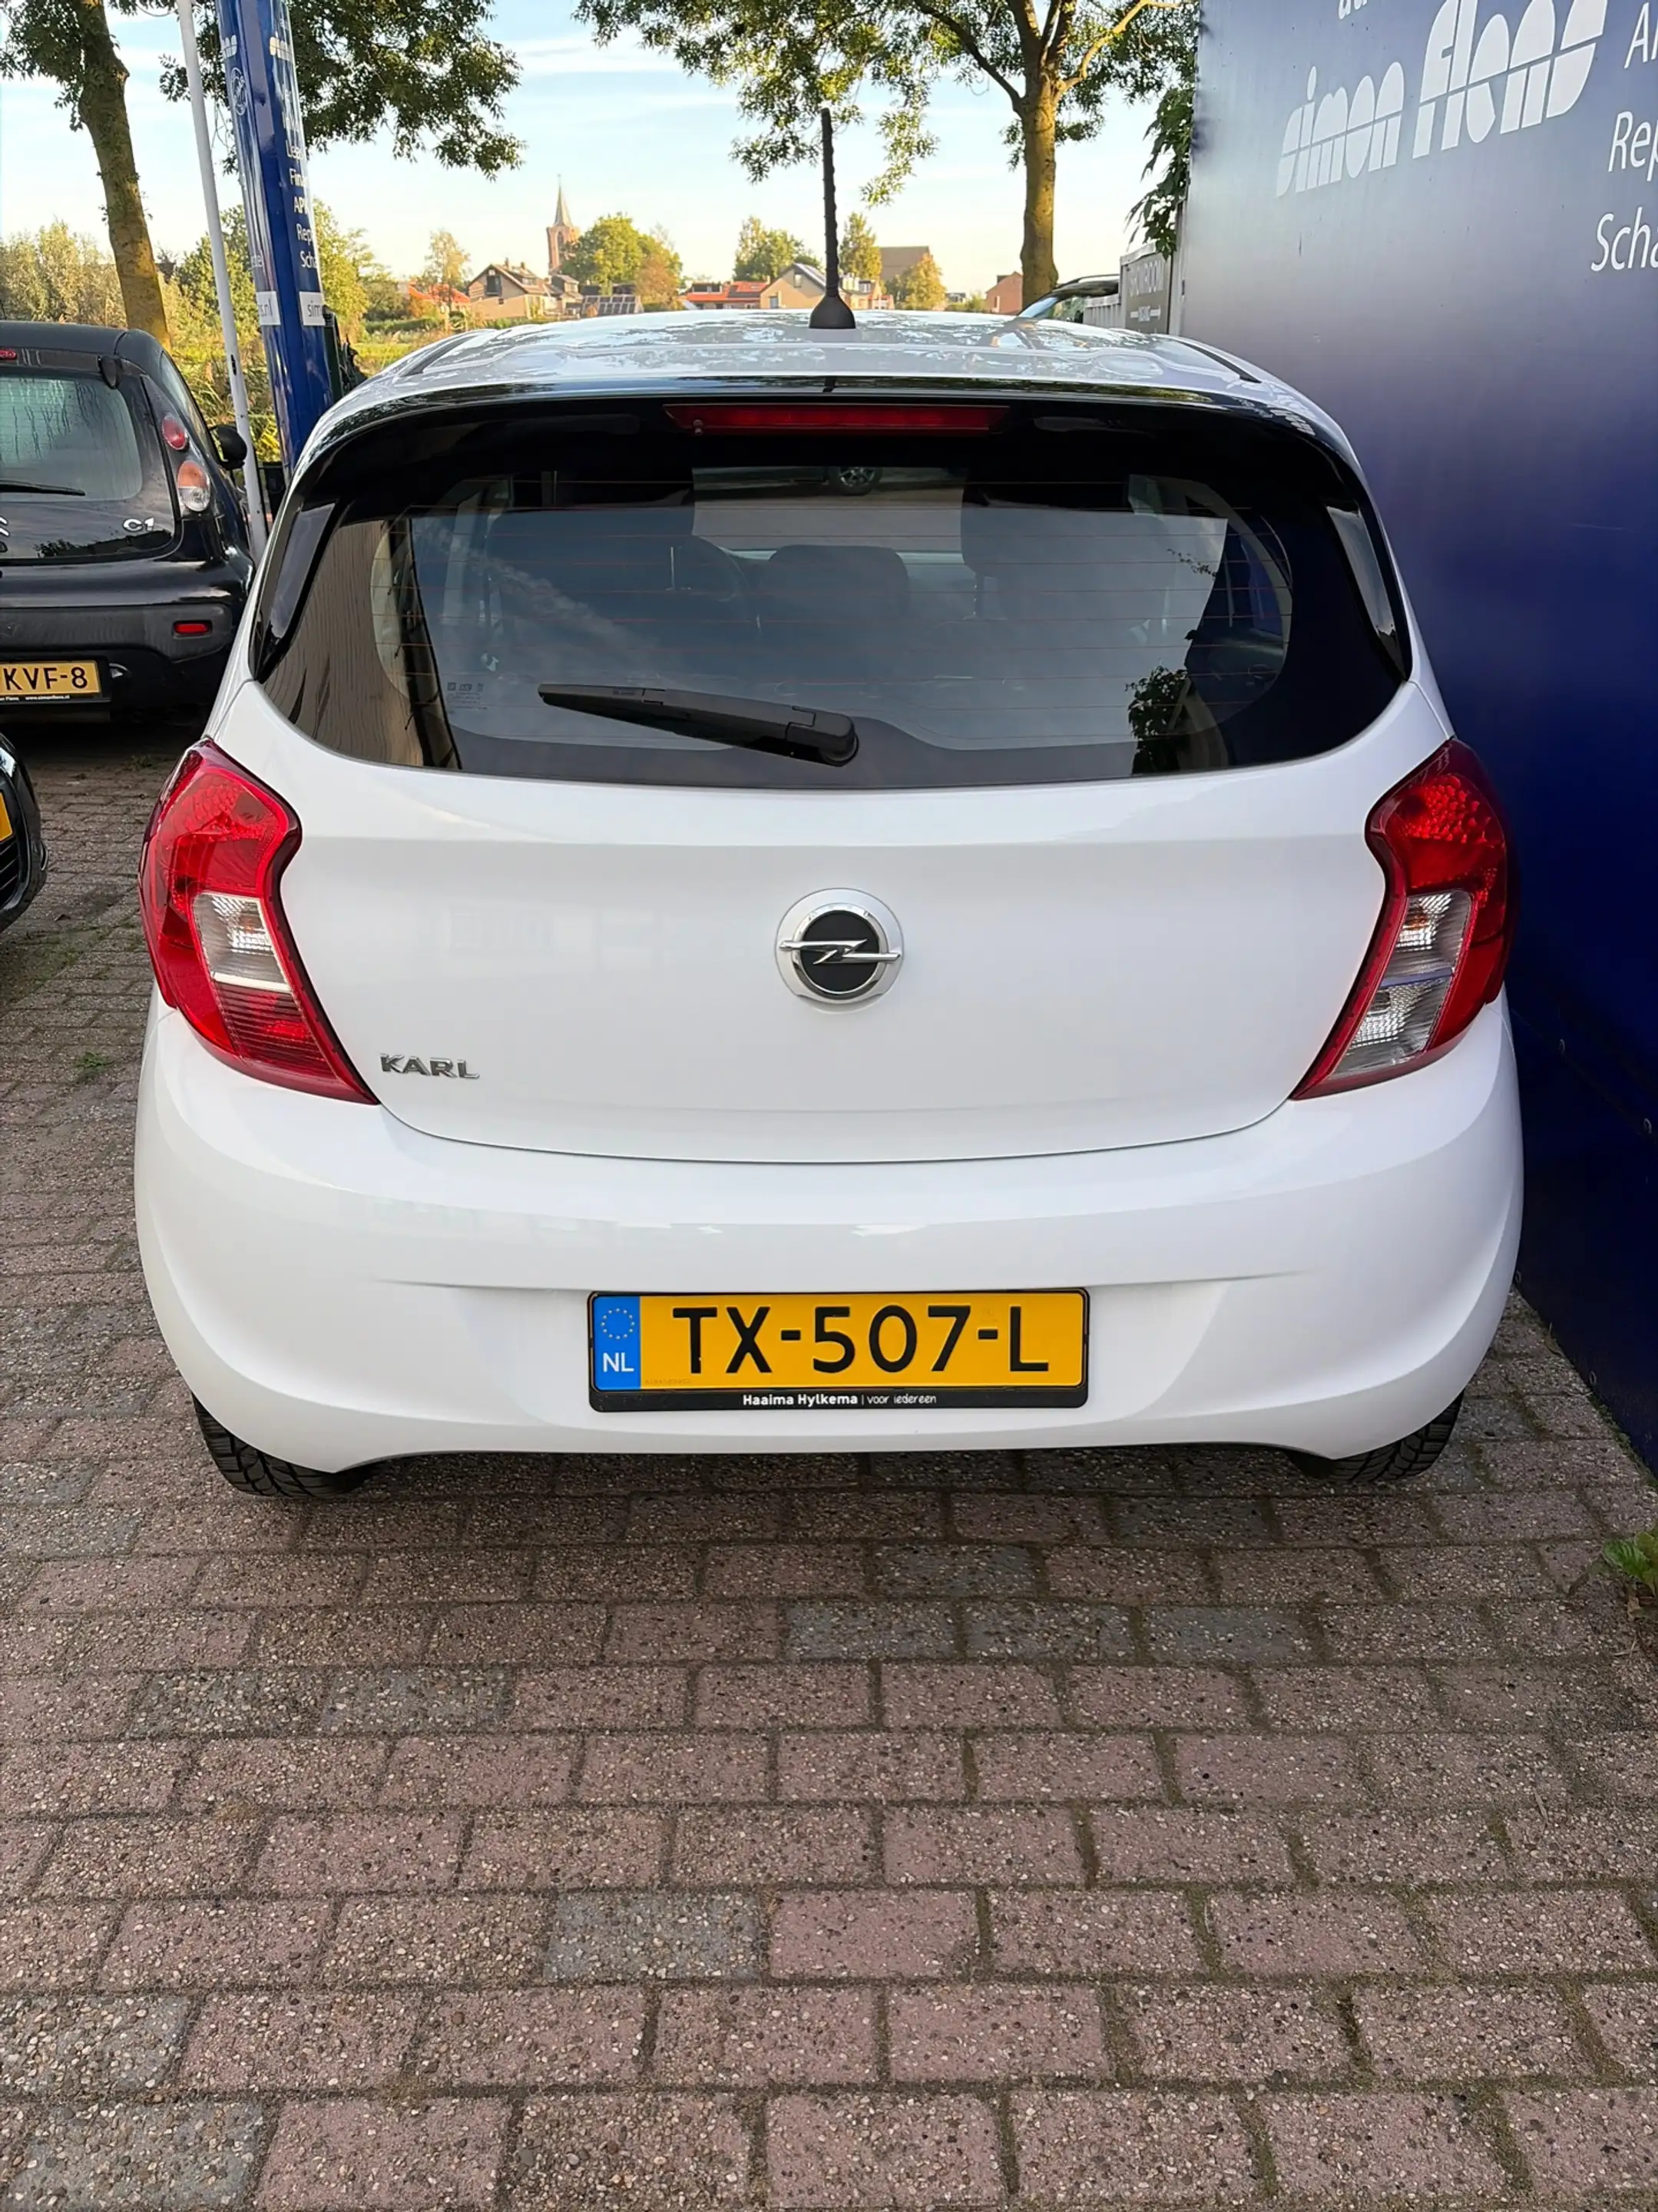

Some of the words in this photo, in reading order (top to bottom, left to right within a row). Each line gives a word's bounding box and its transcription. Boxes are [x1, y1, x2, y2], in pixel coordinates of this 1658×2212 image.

[123, 518, 154, 532] C1
[379, 1053, 481, 1079] KARL
[673, 1305, 1049, 1374] TX-507-L
[603, 1353, 634, 1373] NL
[743, 1394, 793, 1406] Haaima
[798, 1394, 858, 1407] Hylkema
[867, 1396, 889, 1405] voor
[893, 1394, 937, 1405] iedereen
